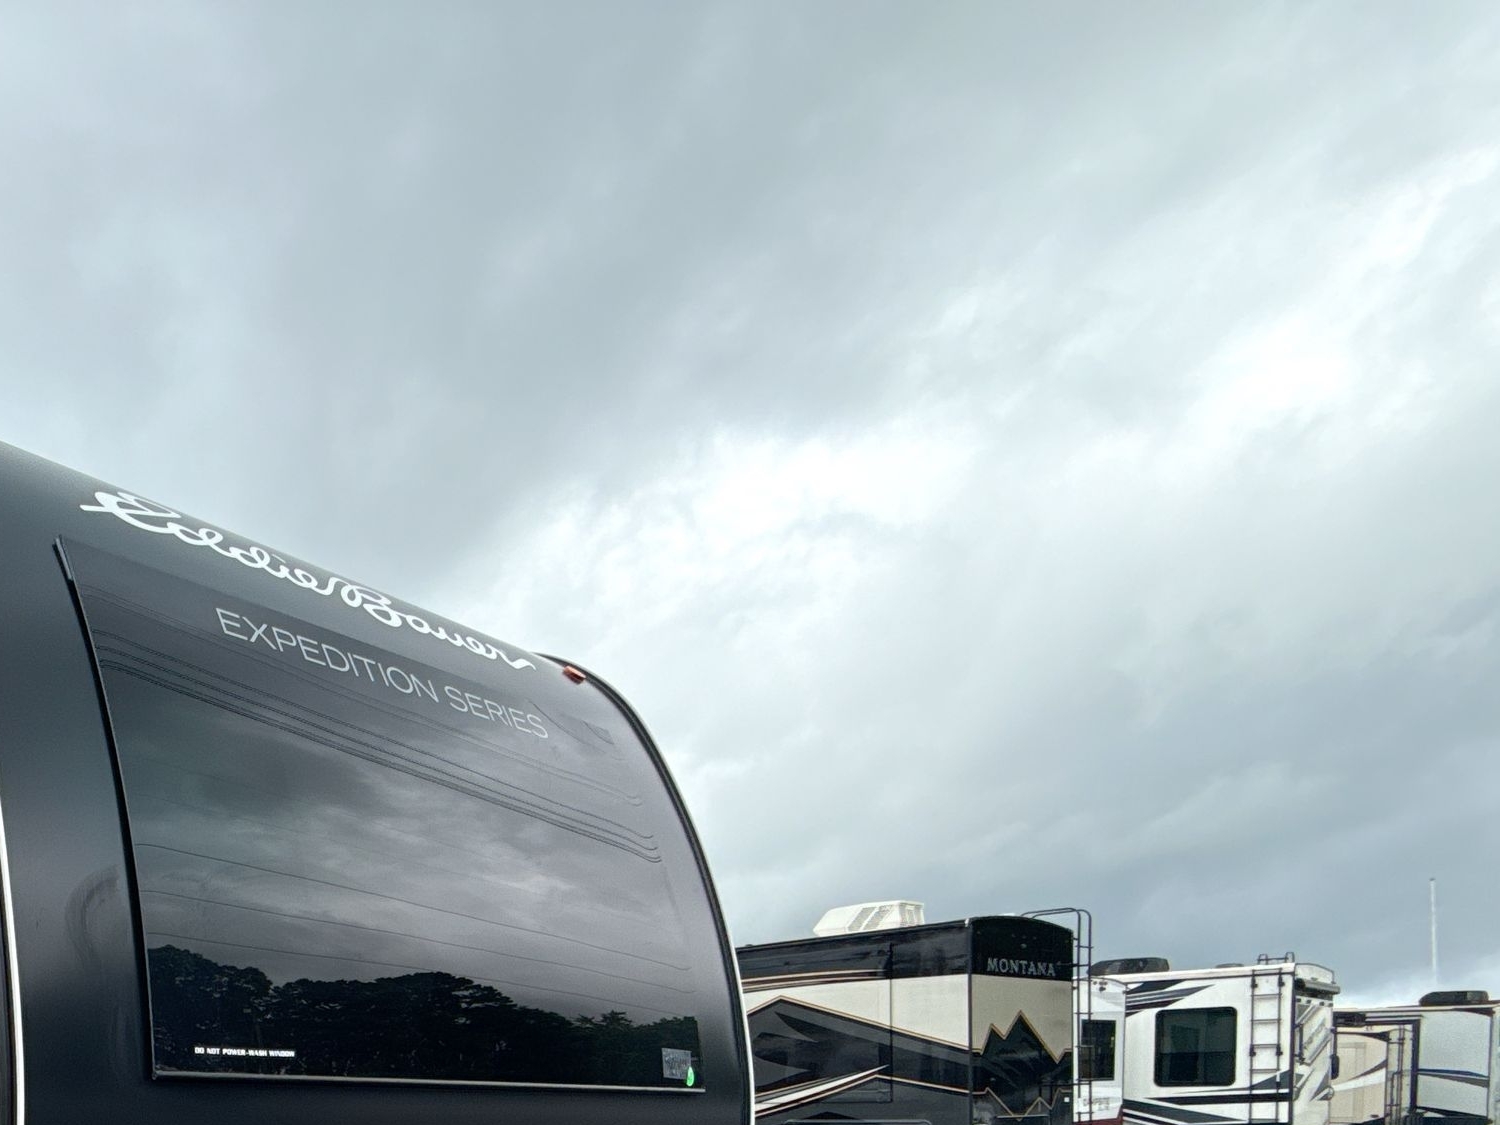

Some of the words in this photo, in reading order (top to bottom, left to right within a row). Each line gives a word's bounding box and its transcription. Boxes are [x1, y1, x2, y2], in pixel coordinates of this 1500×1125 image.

[81, 491, 331, 596] Eddie
[329, 576, 536, 672] Bauer
[216, 607, 439, 704] EXPEDITION
[444, 685, 548, 739] SERIES
[987, 958, 1055, 977] MONTANA
[194, 1046, 205, 1055] DO
[206, 1047, 220, 1055] NOT
